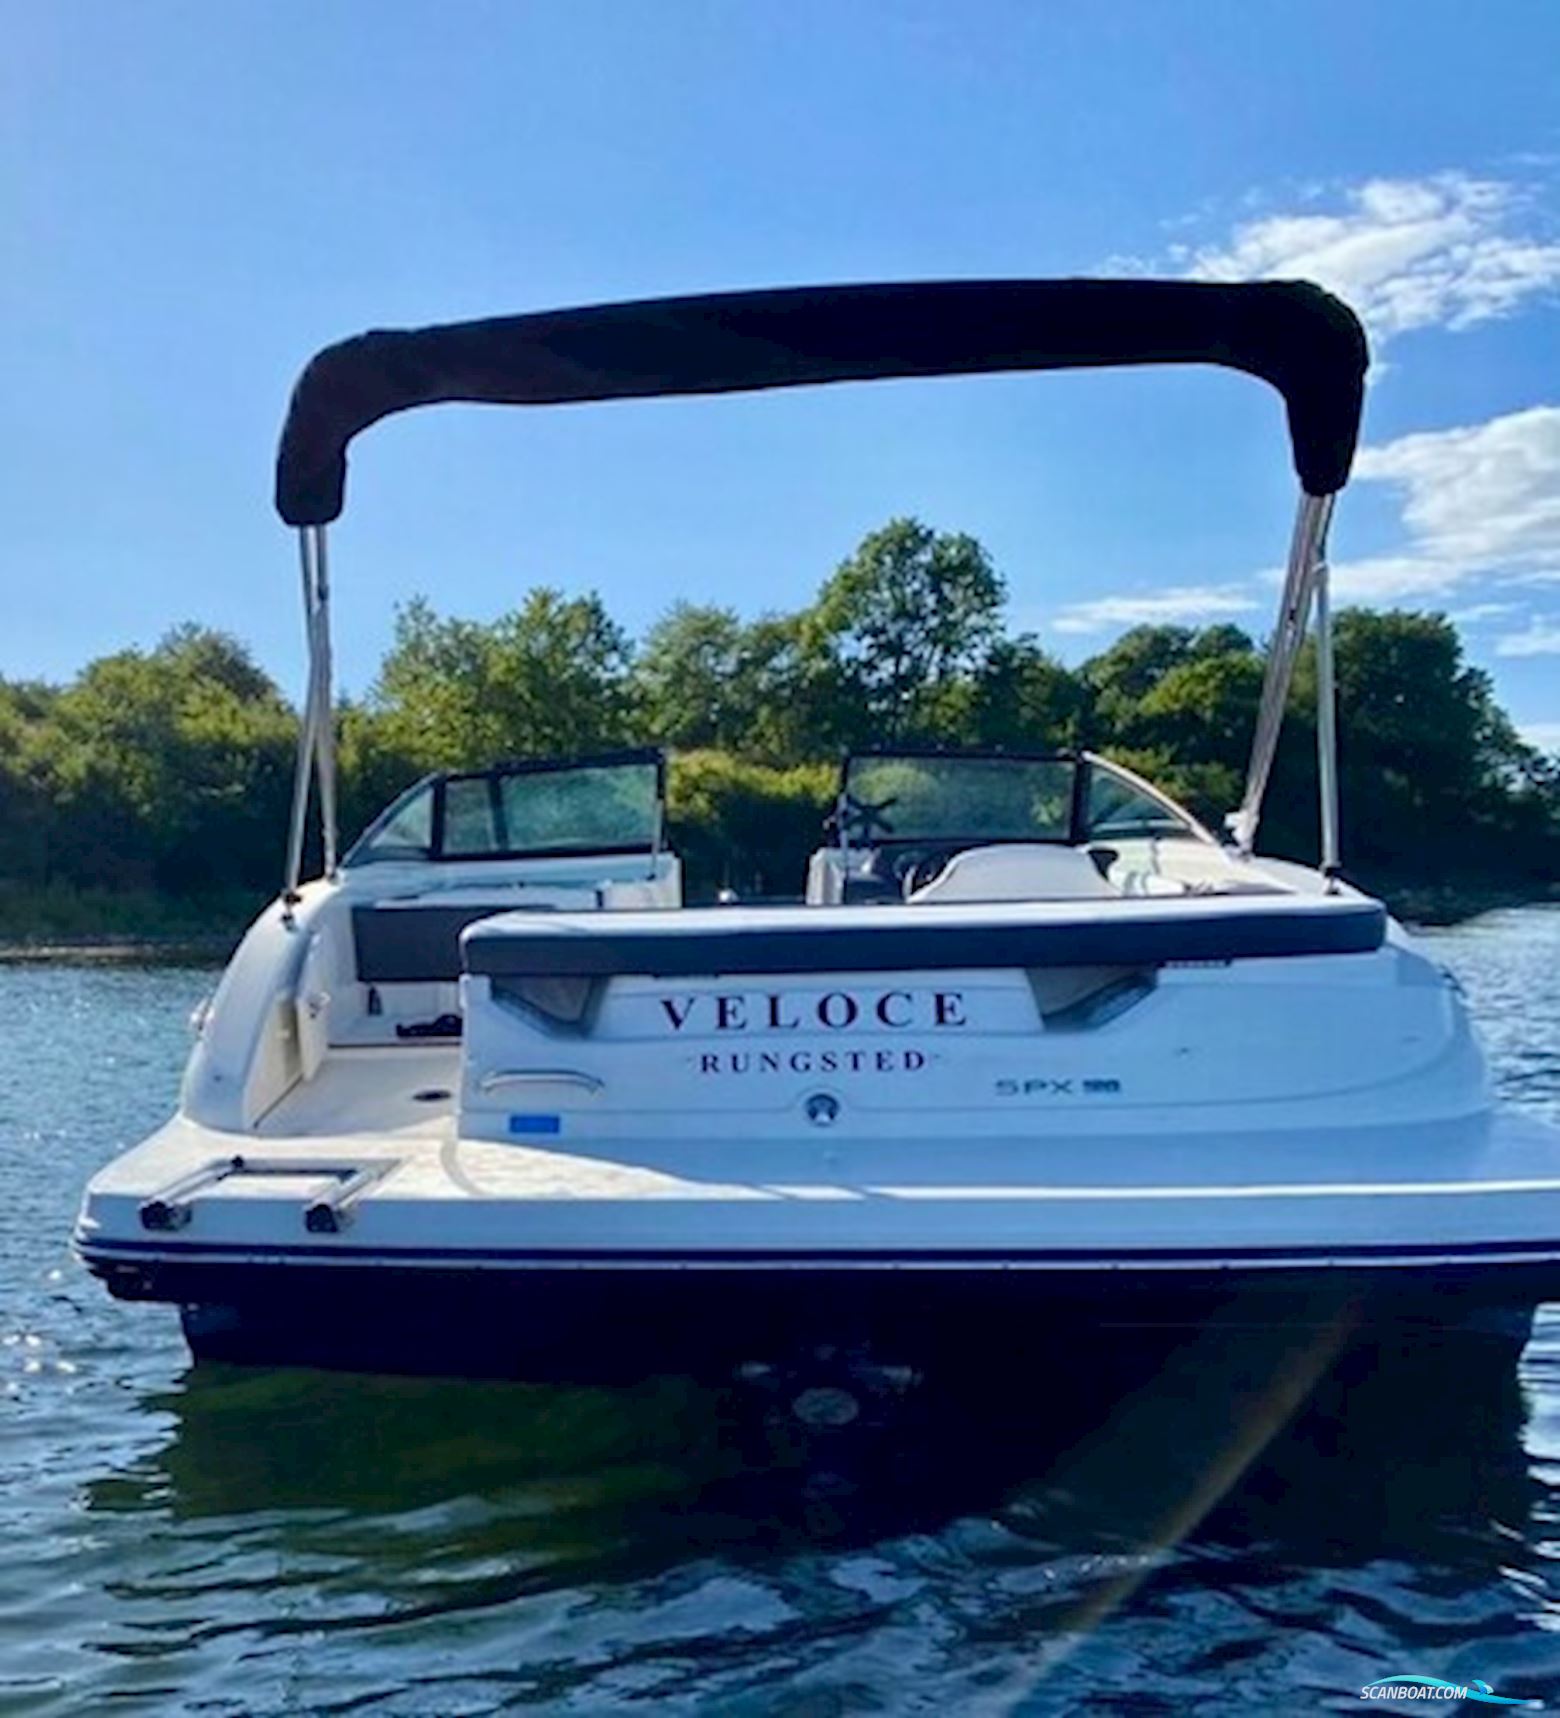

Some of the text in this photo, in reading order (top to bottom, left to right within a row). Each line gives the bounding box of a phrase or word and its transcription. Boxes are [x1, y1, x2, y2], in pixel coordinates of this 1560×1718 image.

[661, 992, 967, 1030] VELOCE
[701, 1051, 925, 1073] RUNGSTED
[995, 1079, 1073, 1096] SPX
